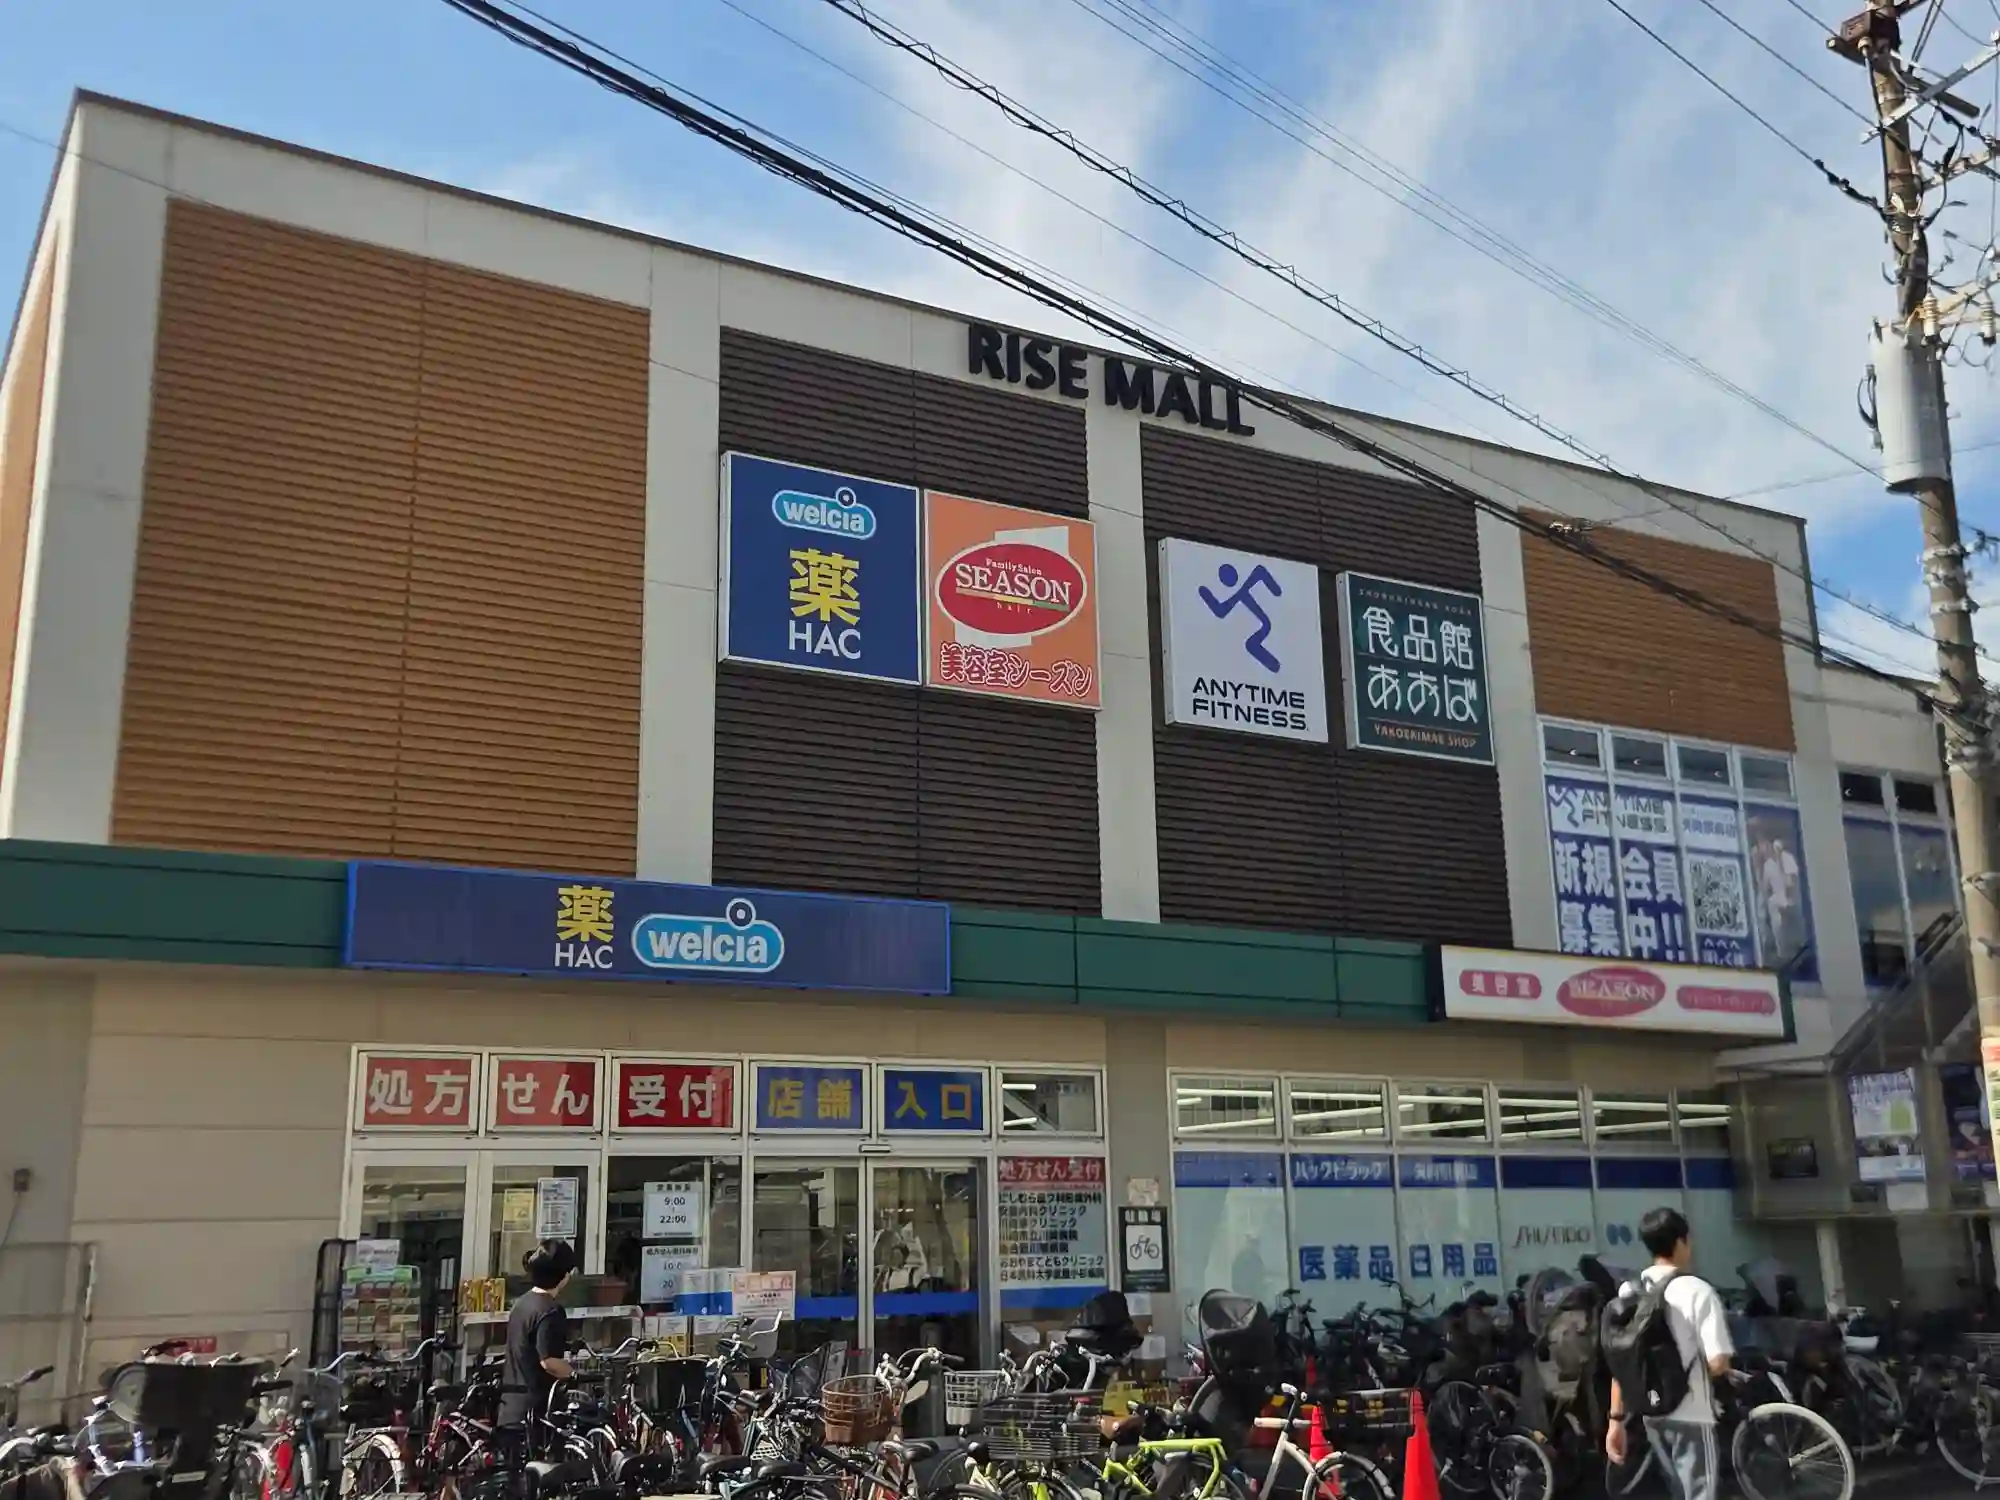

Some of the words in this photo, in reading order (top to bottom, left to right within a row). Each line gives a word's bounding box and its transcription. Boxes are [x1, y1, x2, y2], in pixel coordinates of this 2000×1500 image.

[967, 322, 1089, 399] RISE
[1104, 356, 1256, 436] MALL
[782, 495, 868, 535] welcia
[788, 548, 861, 626] 薬
[955, 562, 1072, 605] SEASON
[996, 601, 1034, 615] hair
[788, 620, 861, 661] HAC
[1362, 605, 1475, 670] 食品館
[940, 641, 1093, 698] 美容室シーズン
[1192, 676, 1306, 710] ANYTIME
[1367, 663, 1479, 724] あおば
[1192, 697, 1307, 731] FITNESS
[1447, 735, 1477, 749] SHOP
[1582, 788, 1665, 816] ANTIME
[1552, 837, 1685, 907] 新規会員
[556, 884, 615, 943] 薬
[554, 943, 613, 969] HAC
[646, 924, 769, 965] welcia
[368, 1066, 468, 1117] 処方
[501, 1071, 591, 1117] せん
[627, 1074, 719, 1120] 受付
[766, 1078, 854, 1121] 店舗
[894, 1080, 972, 1121] 入口
[999, 1159, 1102, 1181] 処方せん受付
[659, 1214, 687, 1224] 22:00
[664, 1196, 686, 1206] 9:00
[1298, 1243, 1395, 1283] 医薬品
[1408, 1242, 1497, 1279] 日用品
